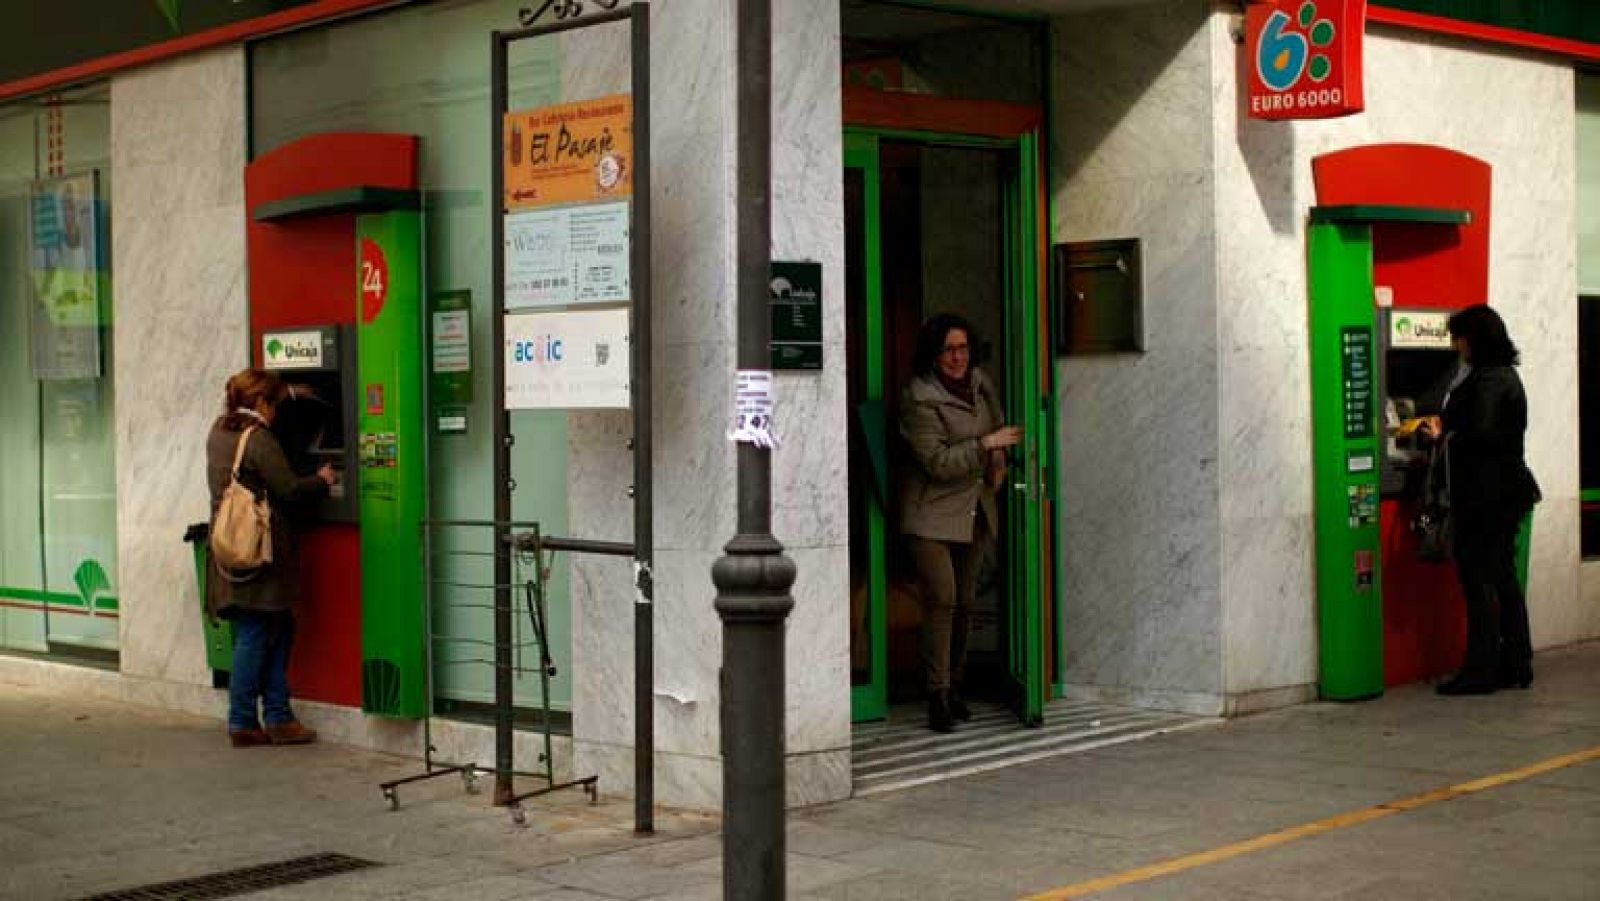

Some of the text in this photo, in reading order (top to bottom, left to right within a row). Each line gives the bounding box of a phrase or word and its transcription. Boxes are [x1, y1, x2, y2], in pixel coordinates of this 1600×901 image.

[1252, 88, 1341, 113] EURO 6000
[530, 133, 550, 165] El
[361, 260, 383, 299] 24
[285, 341, 318, 363] Unicaja
